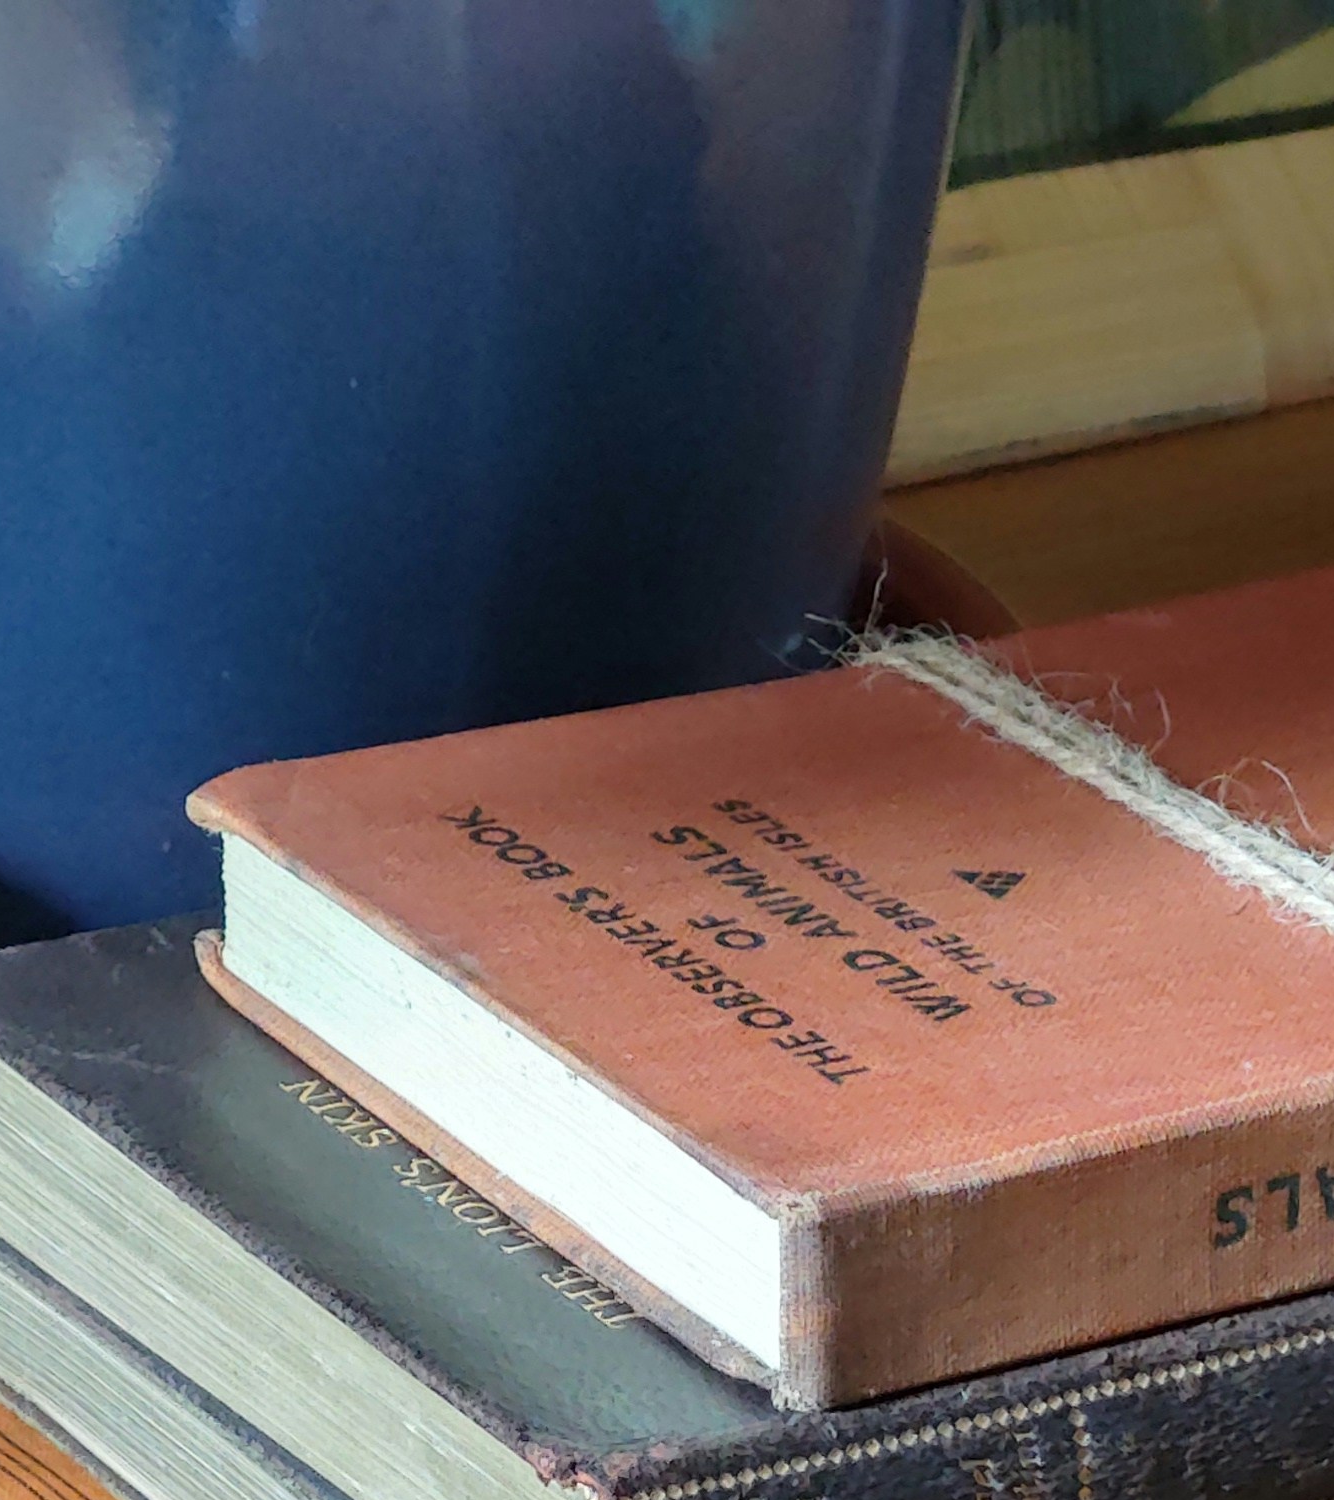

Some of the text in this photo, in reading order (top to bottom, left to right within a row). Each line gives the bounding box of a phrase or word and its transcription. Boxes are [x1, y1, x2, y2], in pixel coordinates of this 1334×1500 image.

[437, 805, 575, 881] BOOK
[650, 823, 973, 1023] WILD ANIMALS
[686, 913, 768, 951] OF
[711, 798, 1059, 1009] OF THE BRITISH ISLES
[772, 1029, 872, 1086] THE
[278, 1078, 399, 1149] SKIN
[540, 1264, 651, 1331] THE
